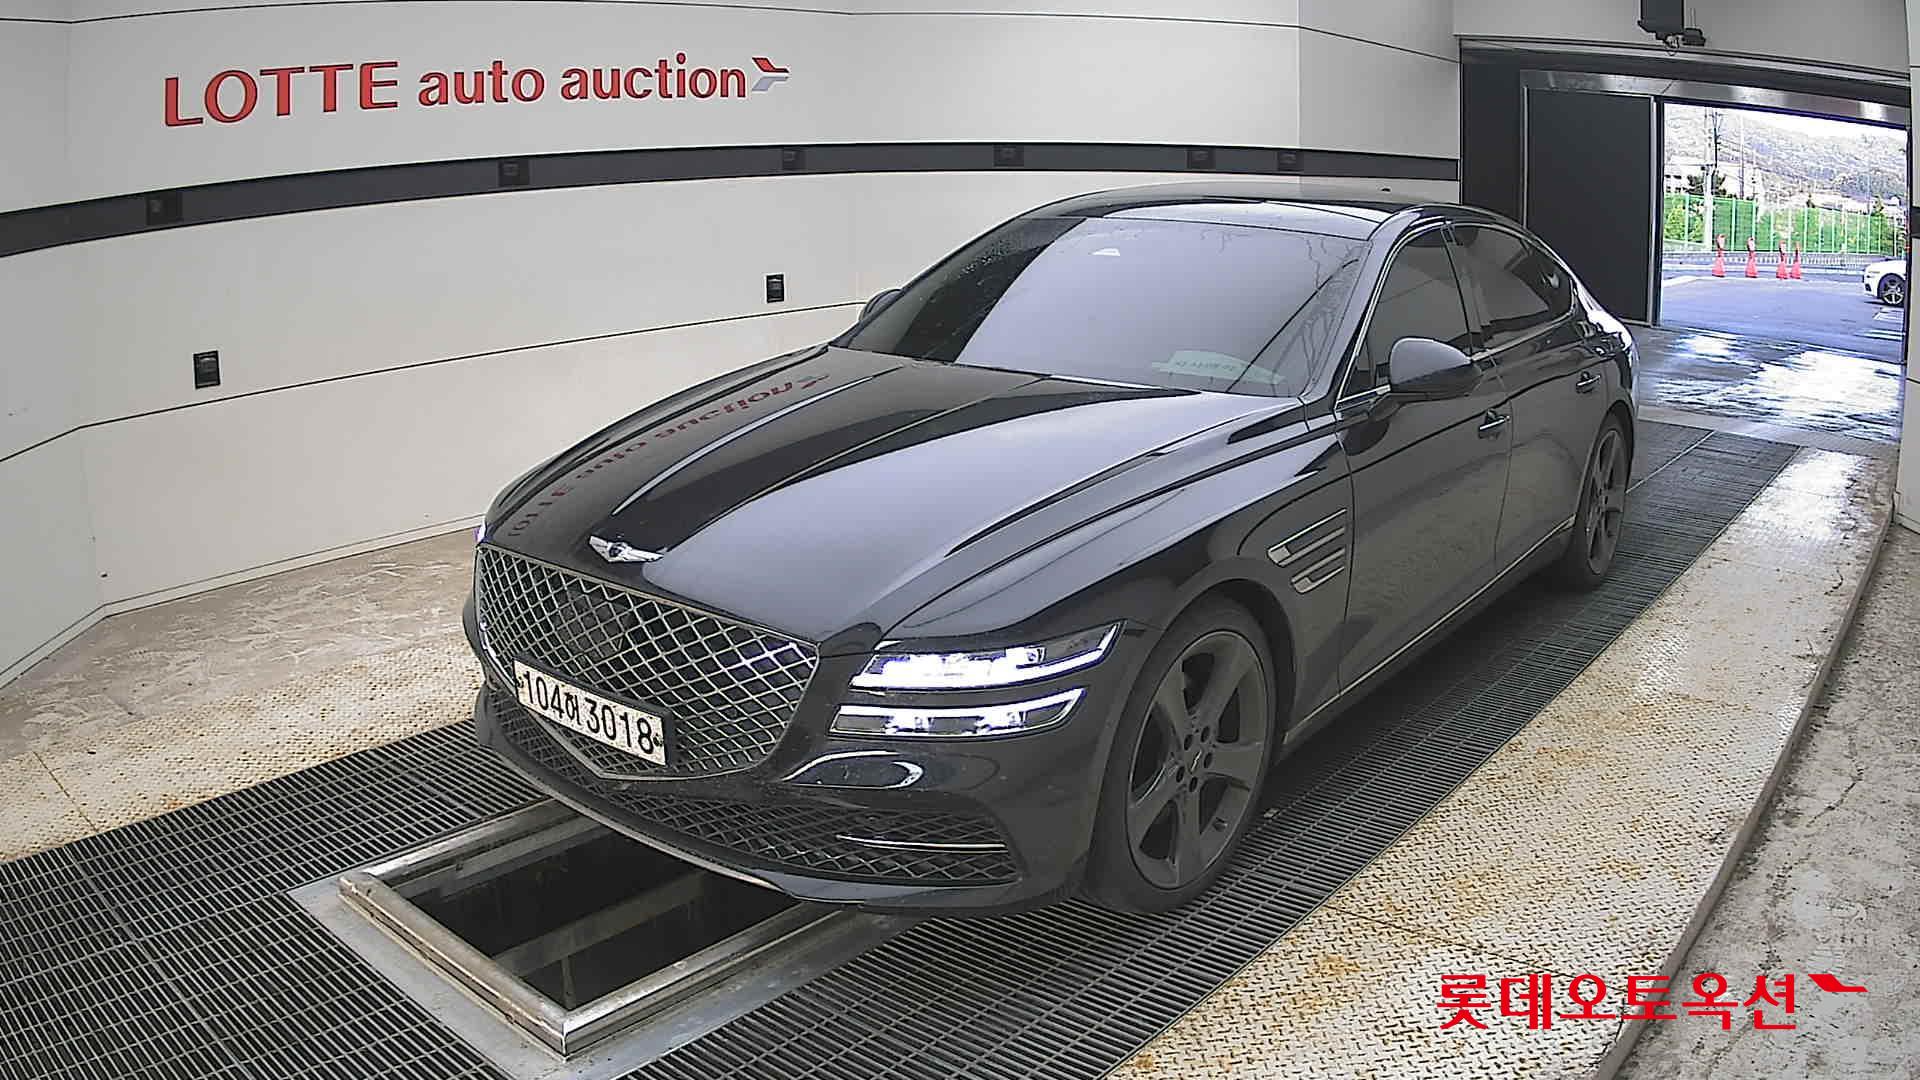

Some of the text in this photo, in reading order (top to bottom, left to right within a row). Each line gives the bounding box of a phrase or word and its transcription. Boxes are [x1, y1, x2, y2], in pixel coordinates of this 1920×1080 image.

[164, 51, 748, 128] LOTTE auto auction
